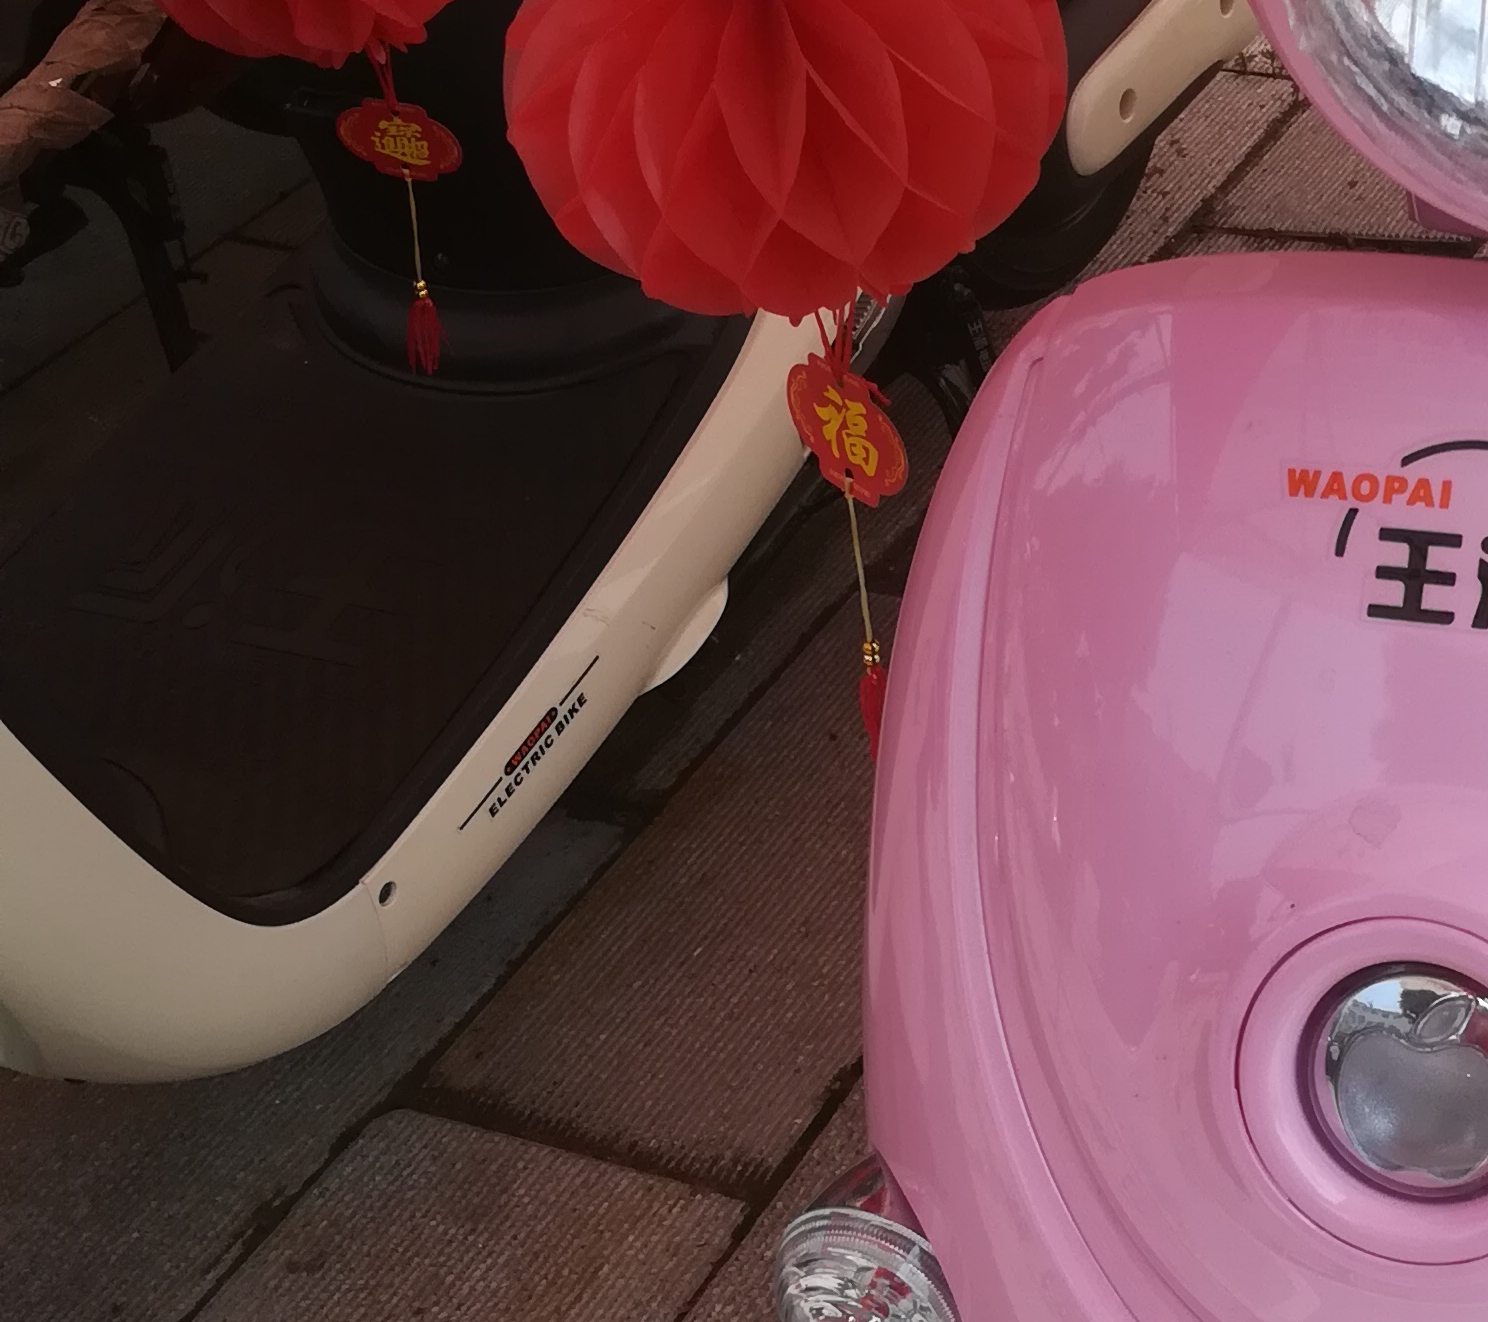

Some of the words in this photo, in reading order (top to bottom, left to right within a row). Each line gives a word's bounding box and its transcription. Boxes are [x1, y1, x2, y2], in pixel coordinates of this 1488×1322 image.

[812, 384, 879, 477] 福
[1287, 468, 1453, 509] WAOPAI
[488, 734, 555, 818] ELECTRIC
[555, 692, 588, 736] BIKE
